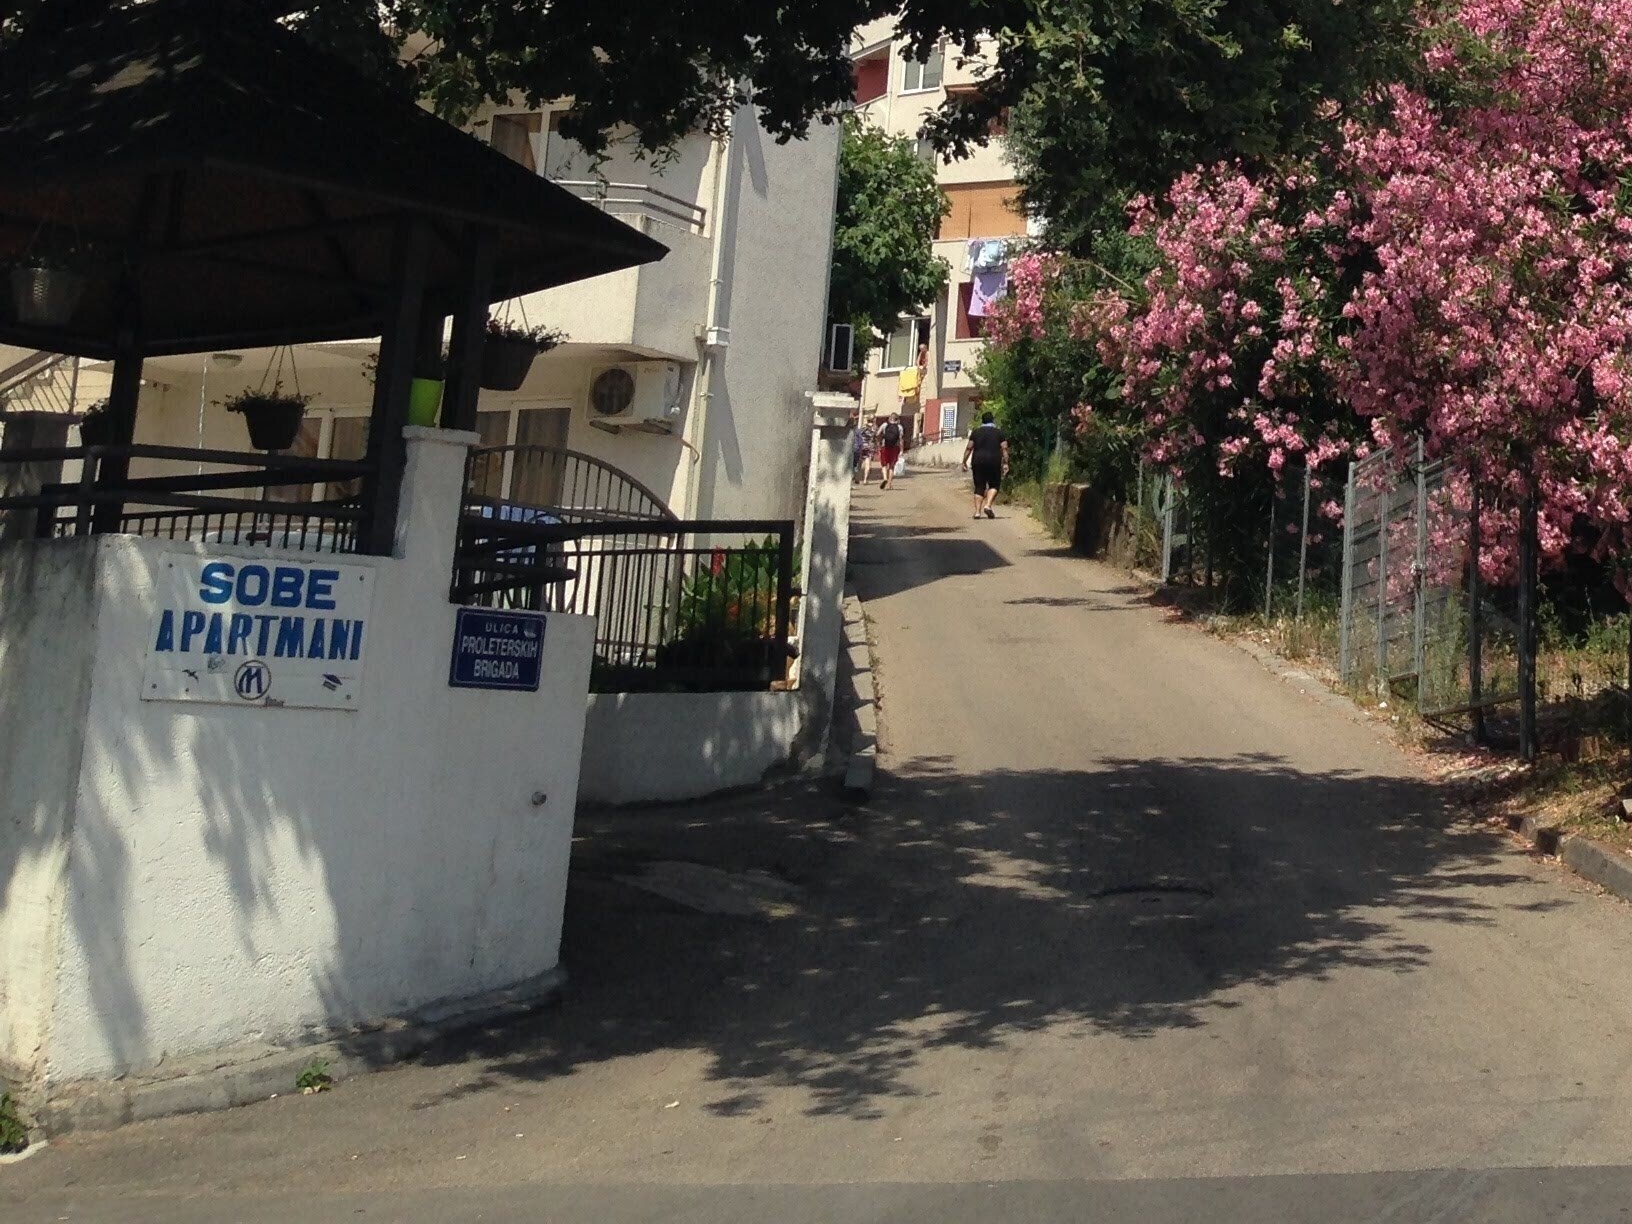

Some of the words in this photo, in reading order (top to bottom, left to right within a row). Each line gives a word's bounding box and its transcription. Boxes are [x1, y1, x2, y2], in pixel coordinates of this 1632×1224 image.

[200, 562, 340, 610] SOBE
[155, 609, 364, 660] APARTMANI
[485, 622, 519, 634] ULICA
[461, 635, 538, 658] PROLETERSKIH
[473, 659, 519, 679] BRIGADA
